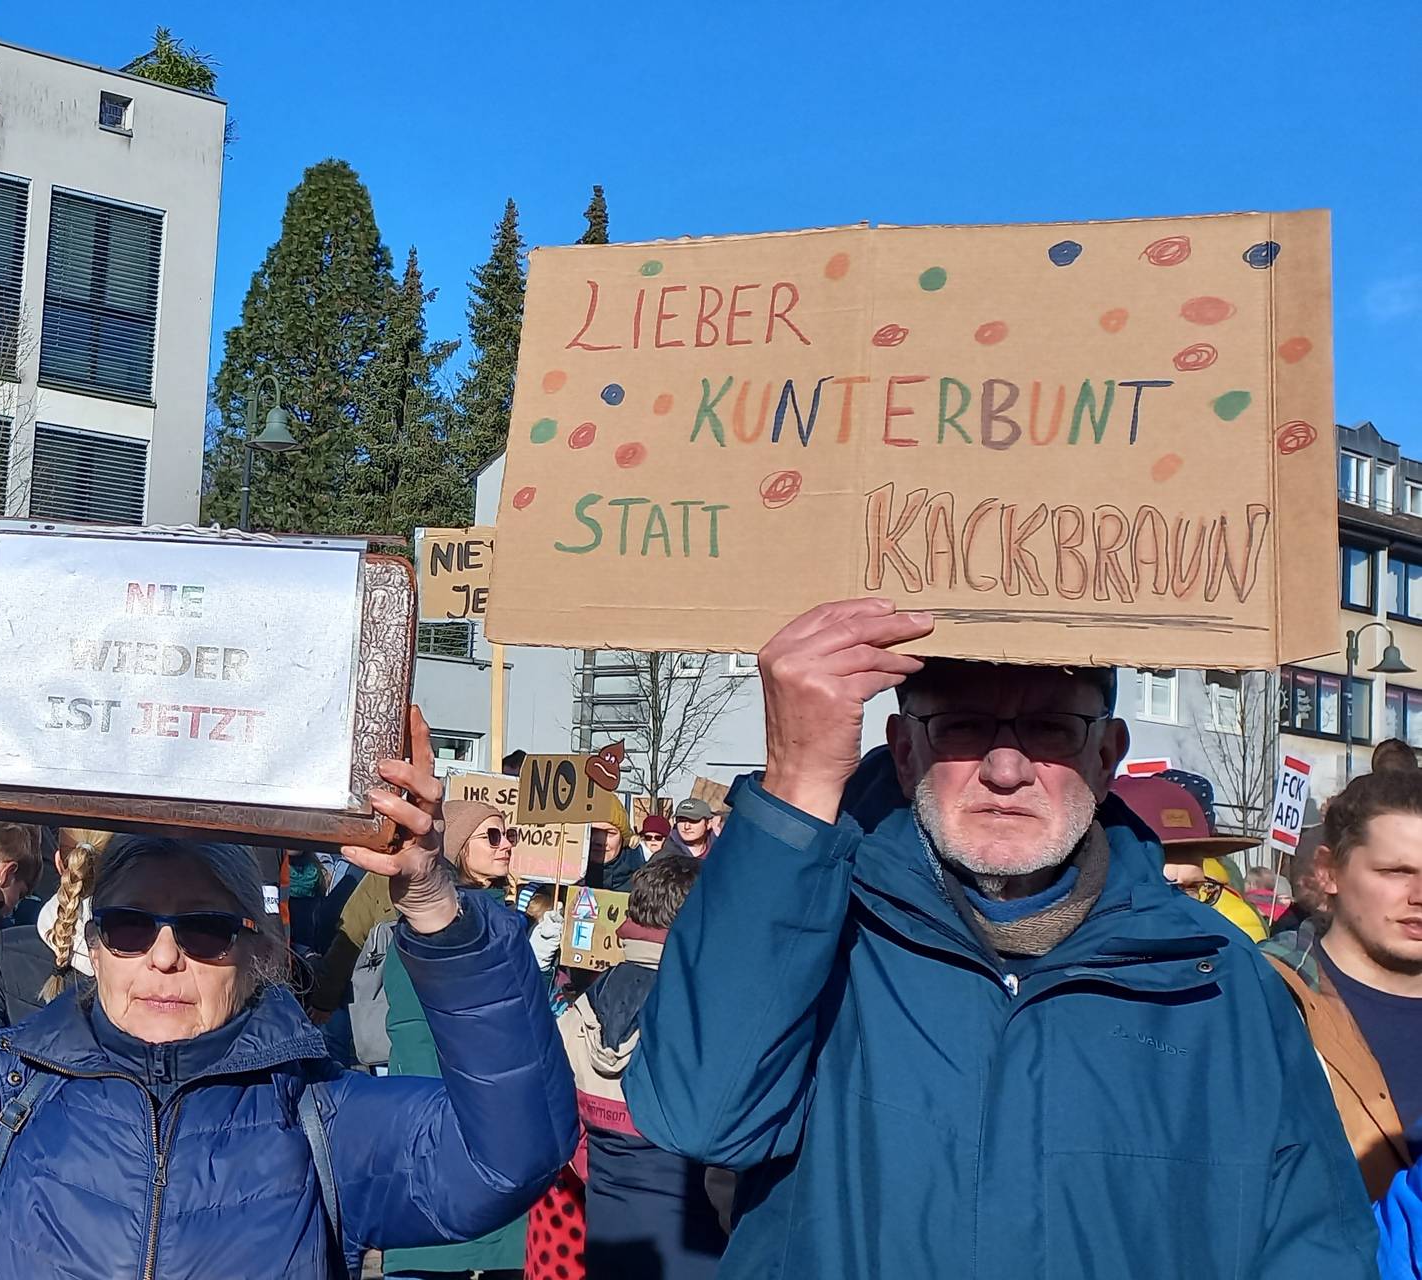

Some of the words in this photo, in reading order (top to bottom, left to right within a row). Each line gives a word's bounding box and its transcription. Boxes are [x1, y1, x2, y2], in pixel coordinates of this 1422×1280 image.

[565, 279, 812, 350] LIEBER
[689, 374, 1176, 448] KUNTERBUNT
[554, 492, 731, 558] STATT
[864, 481, 1272, 604] KACKBRAUN
[125, 582, 206, 619] NIE
[71, 637, 253, 683] WIEDER
[45, 695, 122, 734] IST
[130, 701, 268, 744] JETZT
[463, 785, 491, 803] IHR
[1281, 771, 1306, 802] FCK
[1274, 801, 1301, 831] AFD
